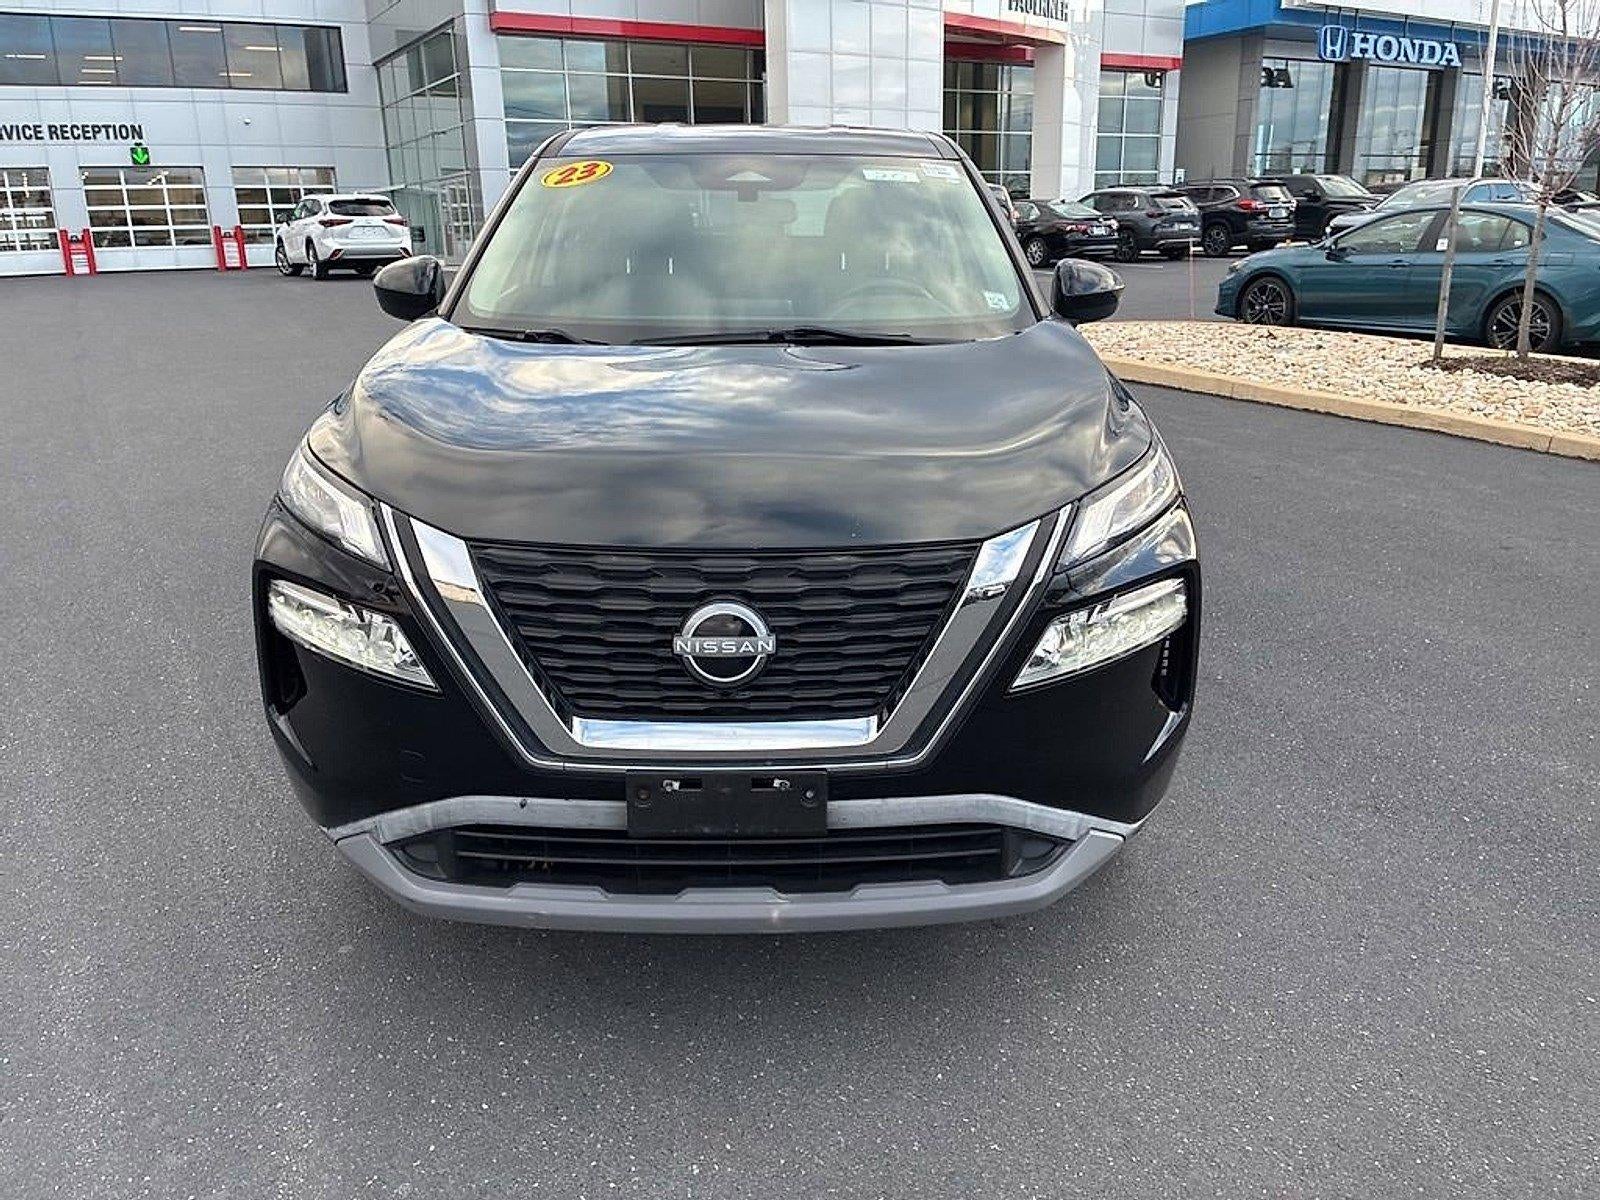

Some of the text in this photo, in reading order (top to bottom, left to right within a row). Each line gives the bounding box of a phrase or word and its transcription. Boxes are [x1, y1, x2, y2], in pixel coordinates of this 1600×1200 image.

[1351, 32, 1462, 67] HONDA
[0, 124, 144, 141] VICE RECEPTION
[554, 162, 600, 185] 23
[676, 640, 774, 654] NISSAN
